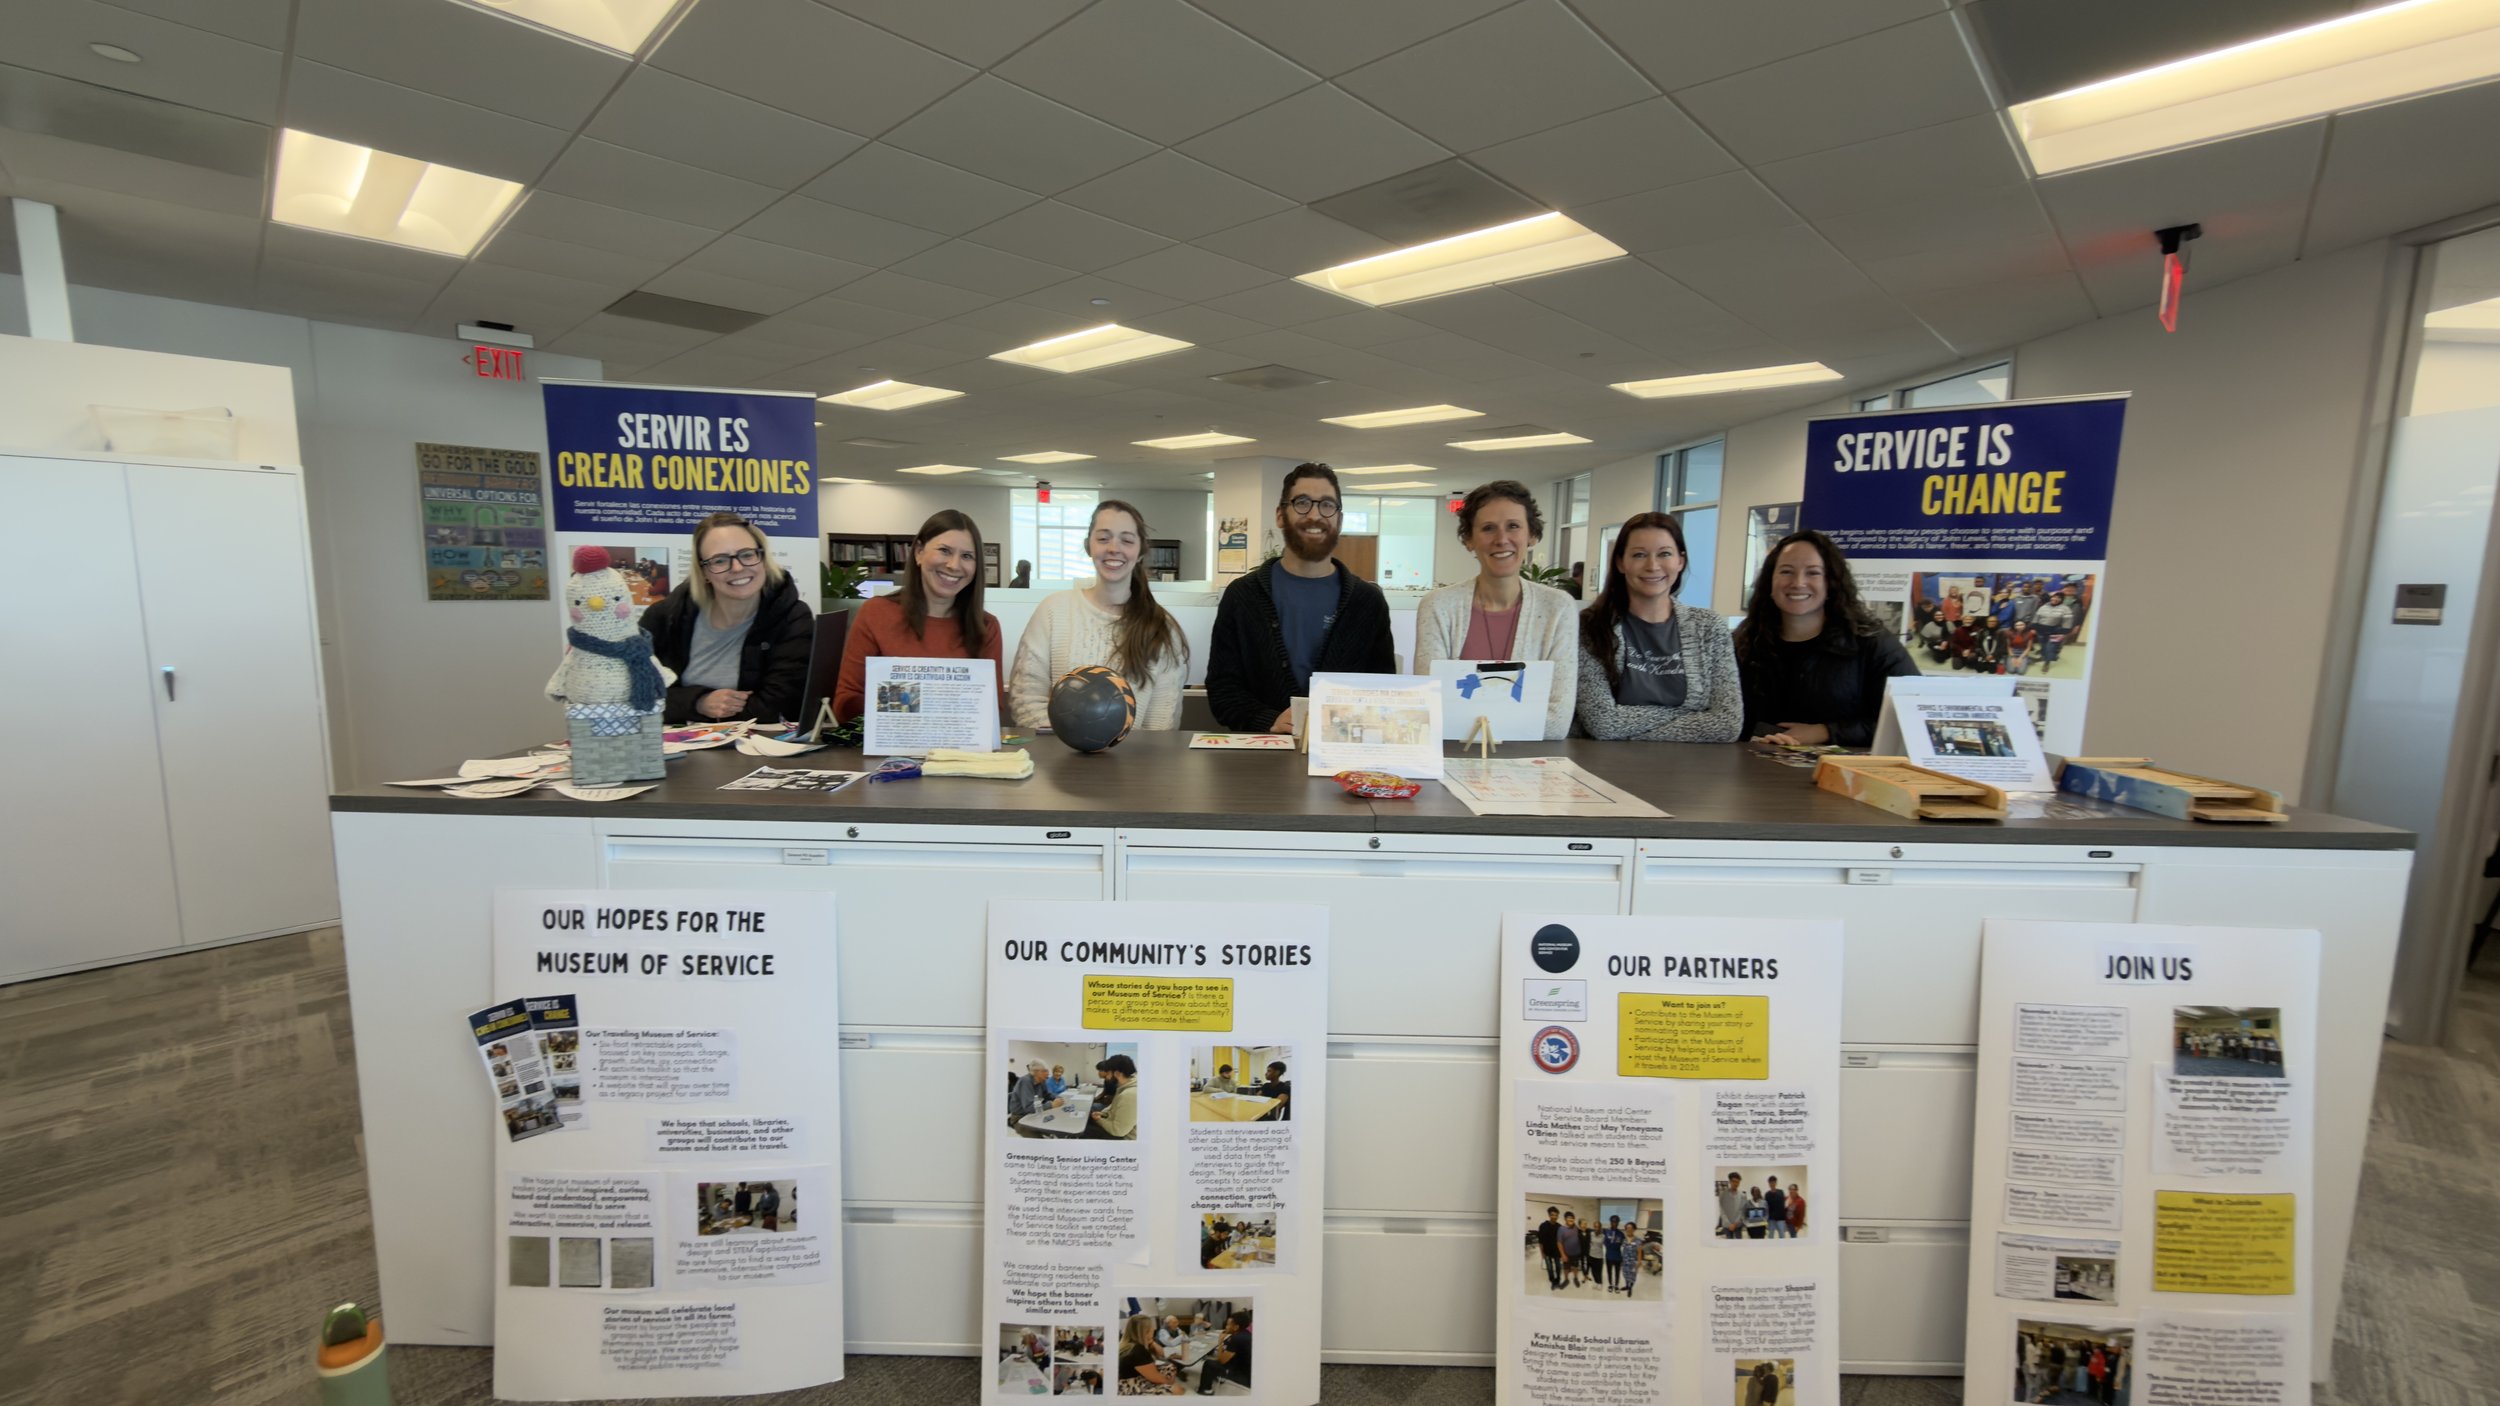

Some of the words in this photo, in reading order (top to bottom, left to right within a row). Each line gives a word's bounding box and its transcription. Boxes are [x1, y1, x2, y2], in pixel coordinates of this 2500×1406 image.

[474, 346, 523, 382] EXIT
[618, 413, 711, 450] SERVIR
[720, 417, 749, 452] ES
[1834, 426, 1968, 472] SERVICE
[1976, 424, 2013, 466] IS
[421, 454, 442, 469] GO
[448, 456, 472, 471] FOR
[477, 458, 499, 473] THE
[505, 460, 537, 475] GOLD
[559, 451, 644, 489] CREAR
[651, 456, 810, 494] CONEXIONES
[423, 487, 473, 500] UNIVERSAL
[476, 490, 517, 502] OPTIONS
[519, 492, 538, 503] FOR
[1921, 471, 2066, 515] CHANGE
[430, 506, 463, 515] WHY
[432, 549, 469, 560] HOW
[542, 909, 585, 930] OUR
[596, 908, 668, 931] HOPES
[677, 911, 718, 933] FOR
[726, 911, 765, 933] THE
[1005, 940, 1047, 961] OUR
[1060, 942, 1206, 965] COMMUNITY'S
[1222, 944, 1312, 965] STORIES
[537, 952, 628, 973] MUSEUM
[641, 954, 668, 975] OF
[682, 955, 774, 976] SERVICE
[1608, 955, 1651, 977] OUR
[1665, 956, 1778, 980] PARTNERS
[2105, 955, 2154, 980] JOIN
[2162, 957, 2192, 980] US
[1152, 991, 1186, 999] Service?
[1529, 999, 1580, 1008] Greenspring
[1634, 1009, 1677, 1017] Contribute
[1735, 1011, 1743, 1019] of
[1665, 1020, 1676, 1028] by
[1634, 1036, 1679, 1044] Participate
[1665, 1045, 1675, 1054] by
[1717, 1046, 1736, 1054] build
[1007, 1154, 1054, 1162] Greenspring
[1533, 1333, 1550, 1343] Key
[1552, 1334, 1581, 1343] Middle
[1584, 1336, 1611, 1344] School
[1613, 1338, 1650, 1346] Librarian
